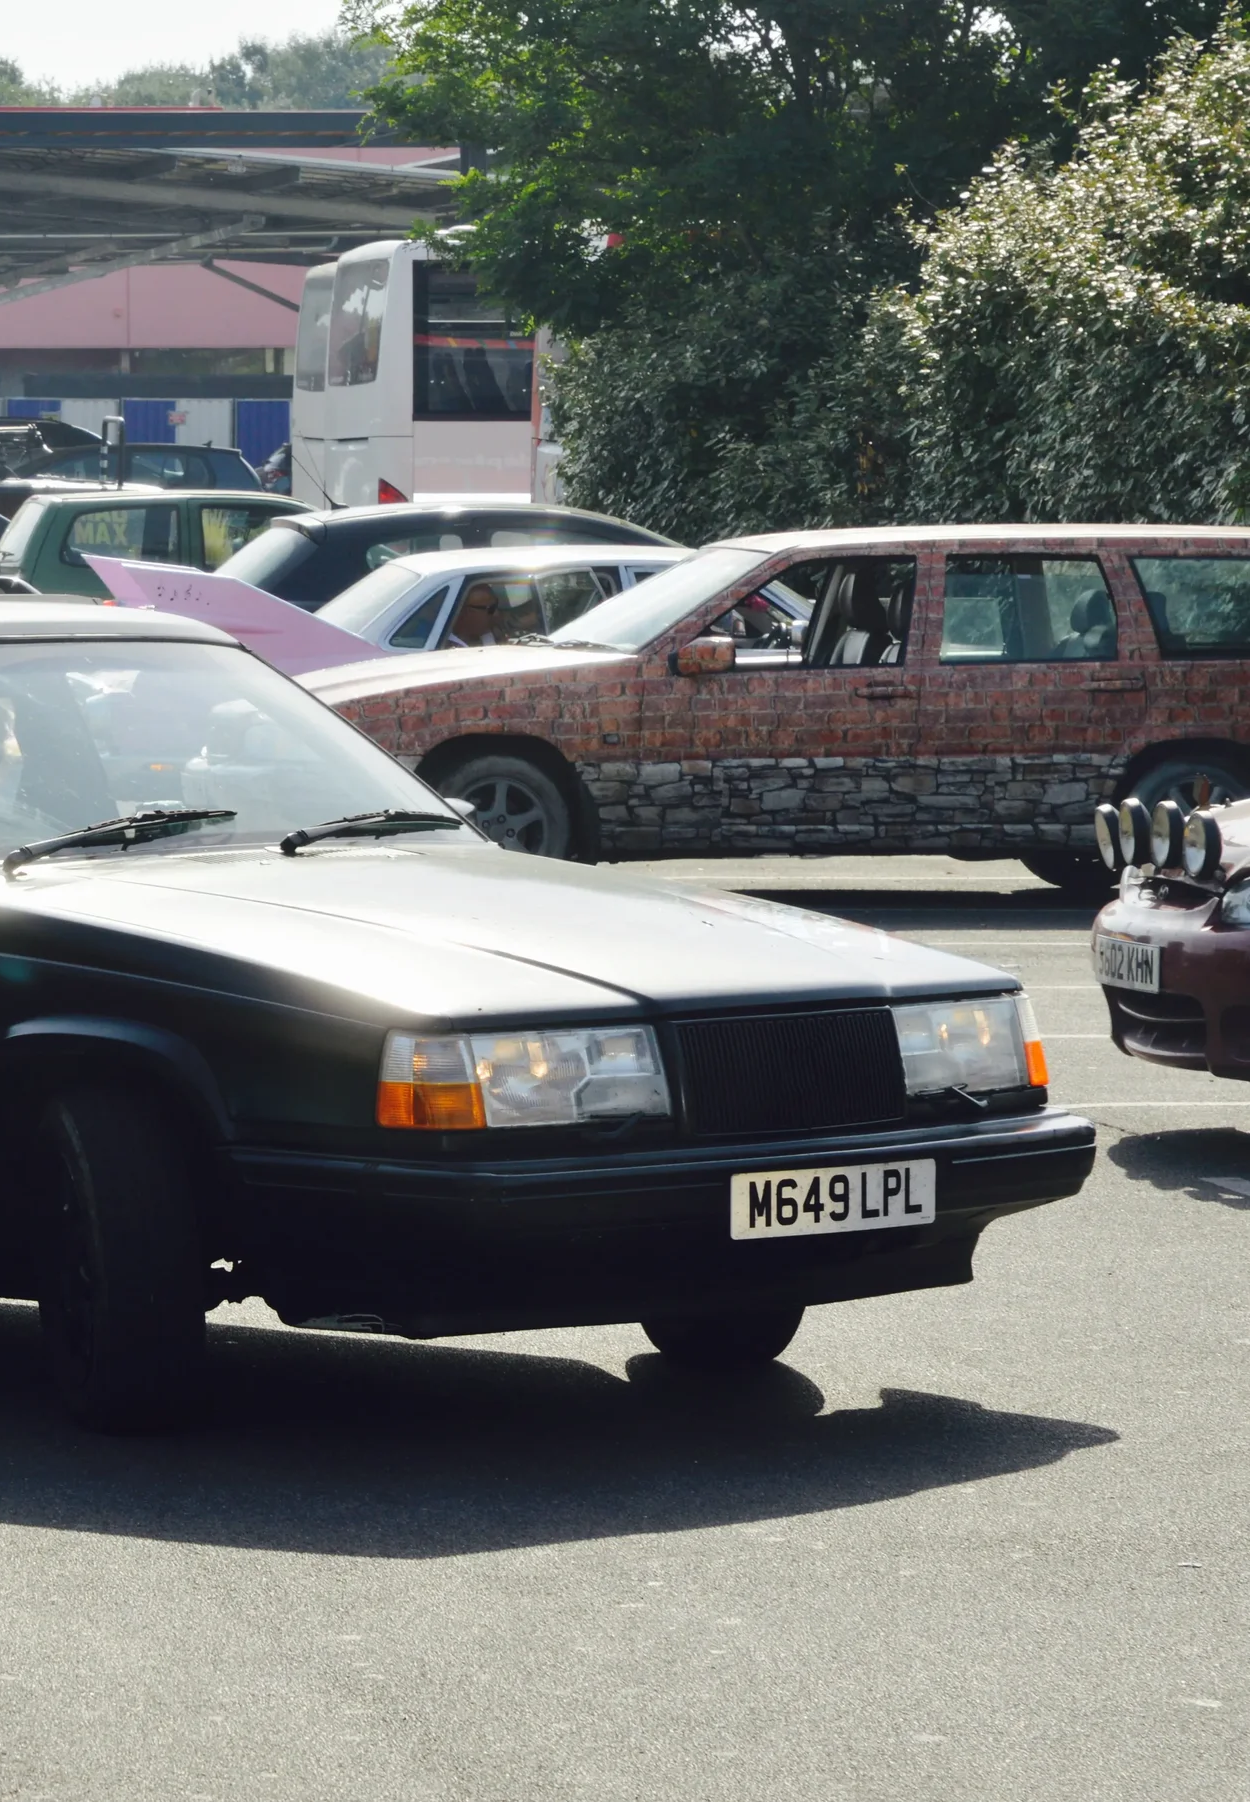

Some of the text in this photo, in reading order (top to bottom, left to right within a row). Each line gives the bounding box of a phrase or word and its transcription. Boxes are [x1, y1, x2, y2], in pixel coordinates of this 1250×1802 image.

[74, 521, 128, 546] MAX
[1126, 946, 1154, 985] KHN
[749, 1167, 922, 1228] M649 LPL
